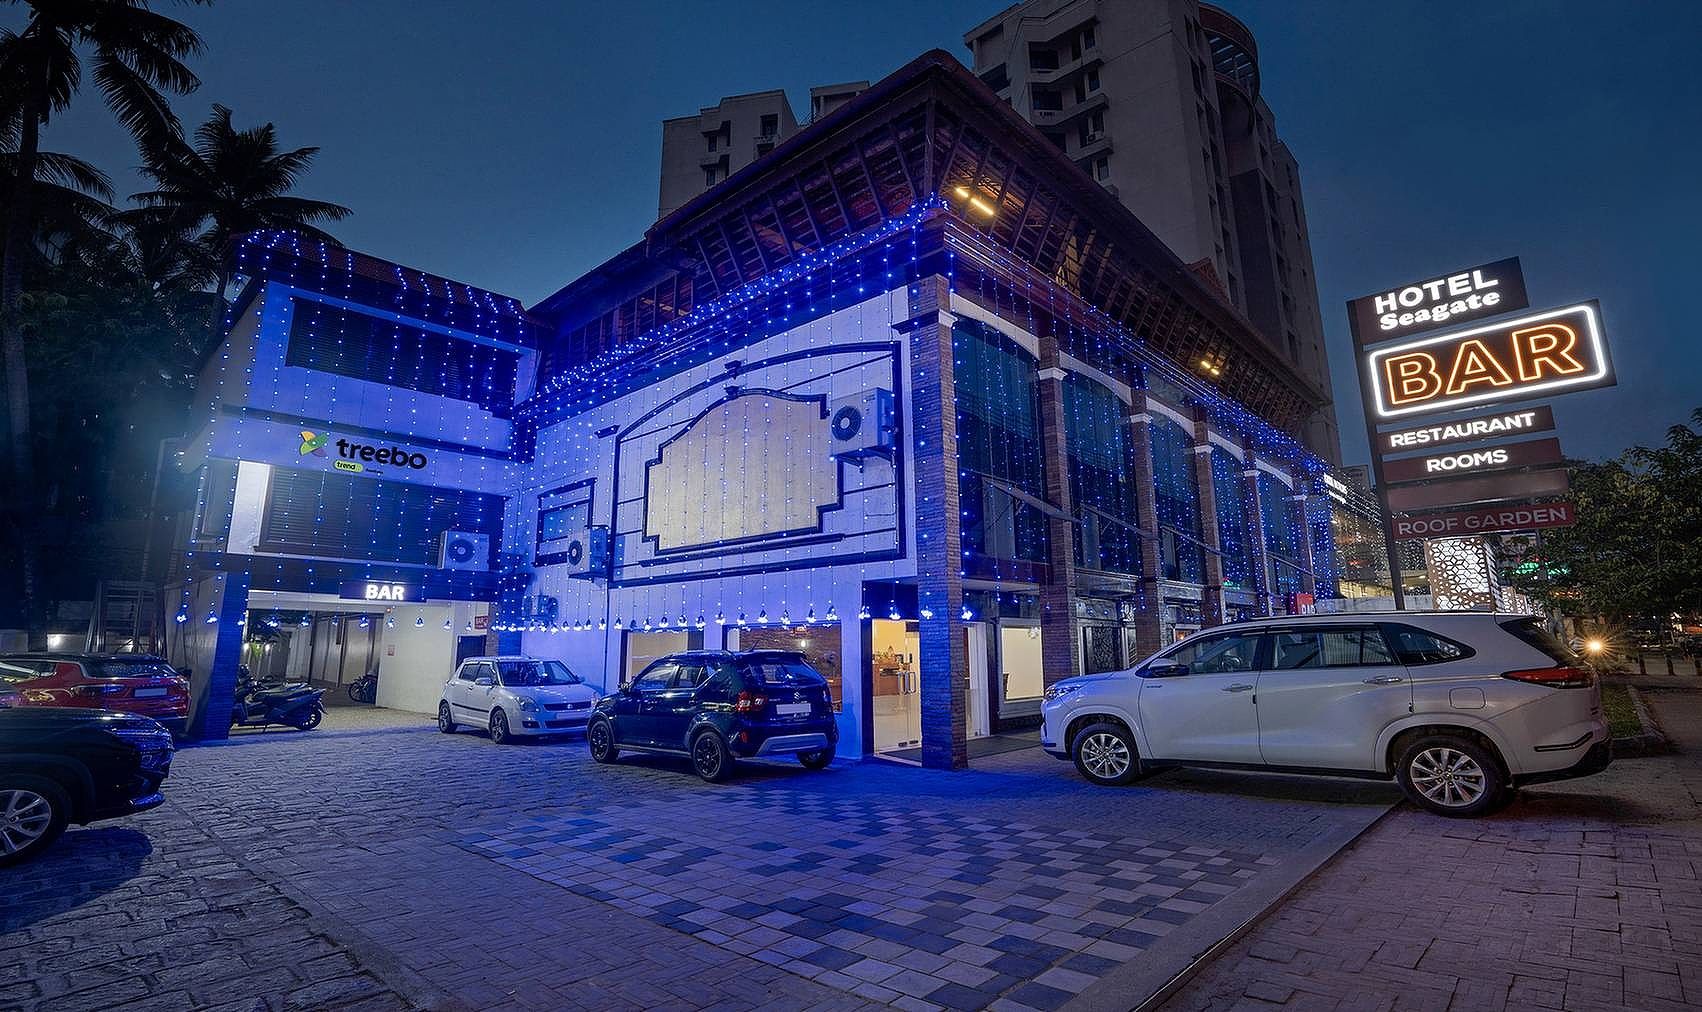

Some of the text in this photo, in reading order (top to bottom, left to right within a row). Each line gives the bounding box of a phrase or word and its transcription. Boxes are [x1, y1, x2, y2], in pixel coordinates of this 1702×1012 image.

[1374, 269, 1499, 315] HOTEL
[1379, 290, 1501, 331] Seagate
[1384, 323, 1584, 405] BAR
[1390, 412, 1536, 447] RESTAURANT
[336, 438, 428, 470] treebo
[336, 461, 356, 470] trend
[1426, 449, 1509, 473] ROOMS
[1398, 507, 1567, 536] ROOF GARDEN
[364, 584, 404, 601] BAR
